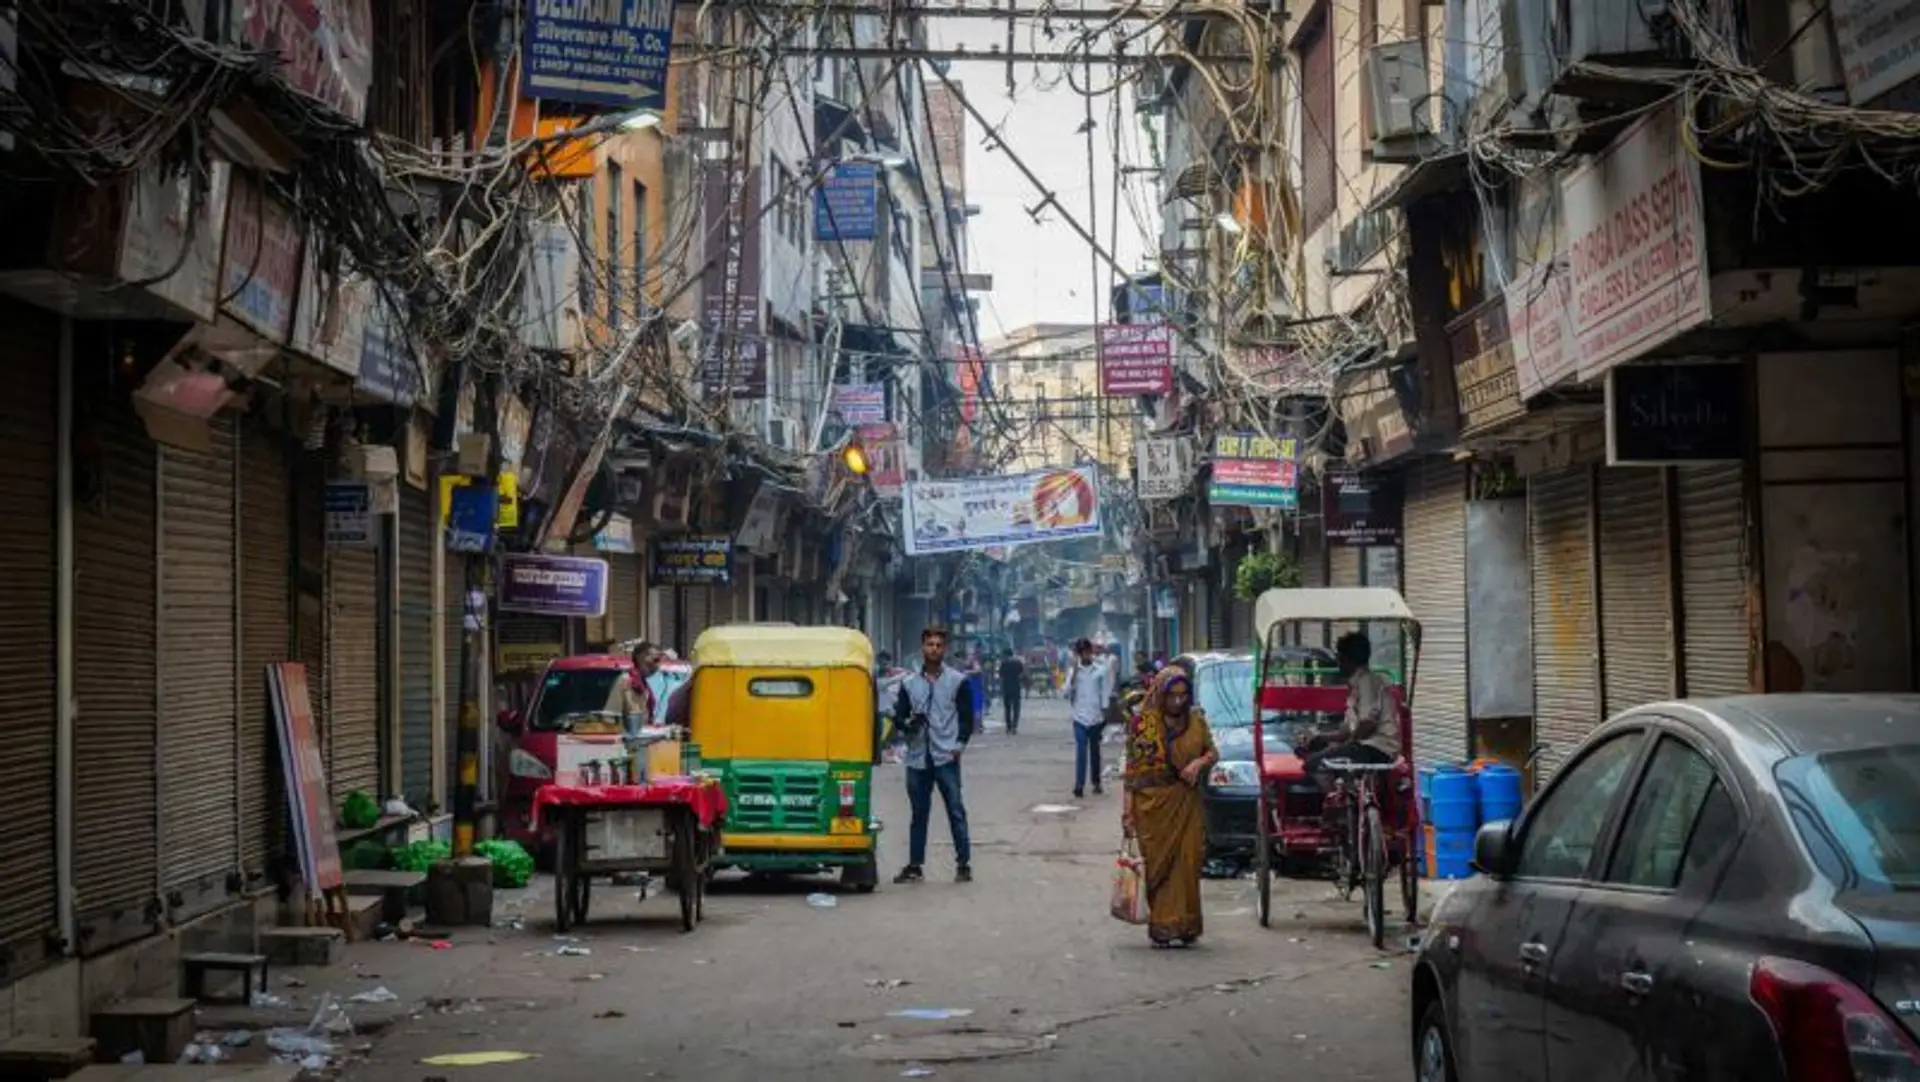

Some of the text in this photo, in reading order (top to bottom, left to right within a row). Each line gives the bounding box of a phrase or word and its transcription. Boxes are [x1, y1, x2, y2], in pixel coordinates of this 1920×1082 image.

[626, 0, 671, 31] JAIN
[536, 20, 609, 46] Silverware
[643, 32, 666, 53] Co.
[1615, 191, 1651, 259] DASS
